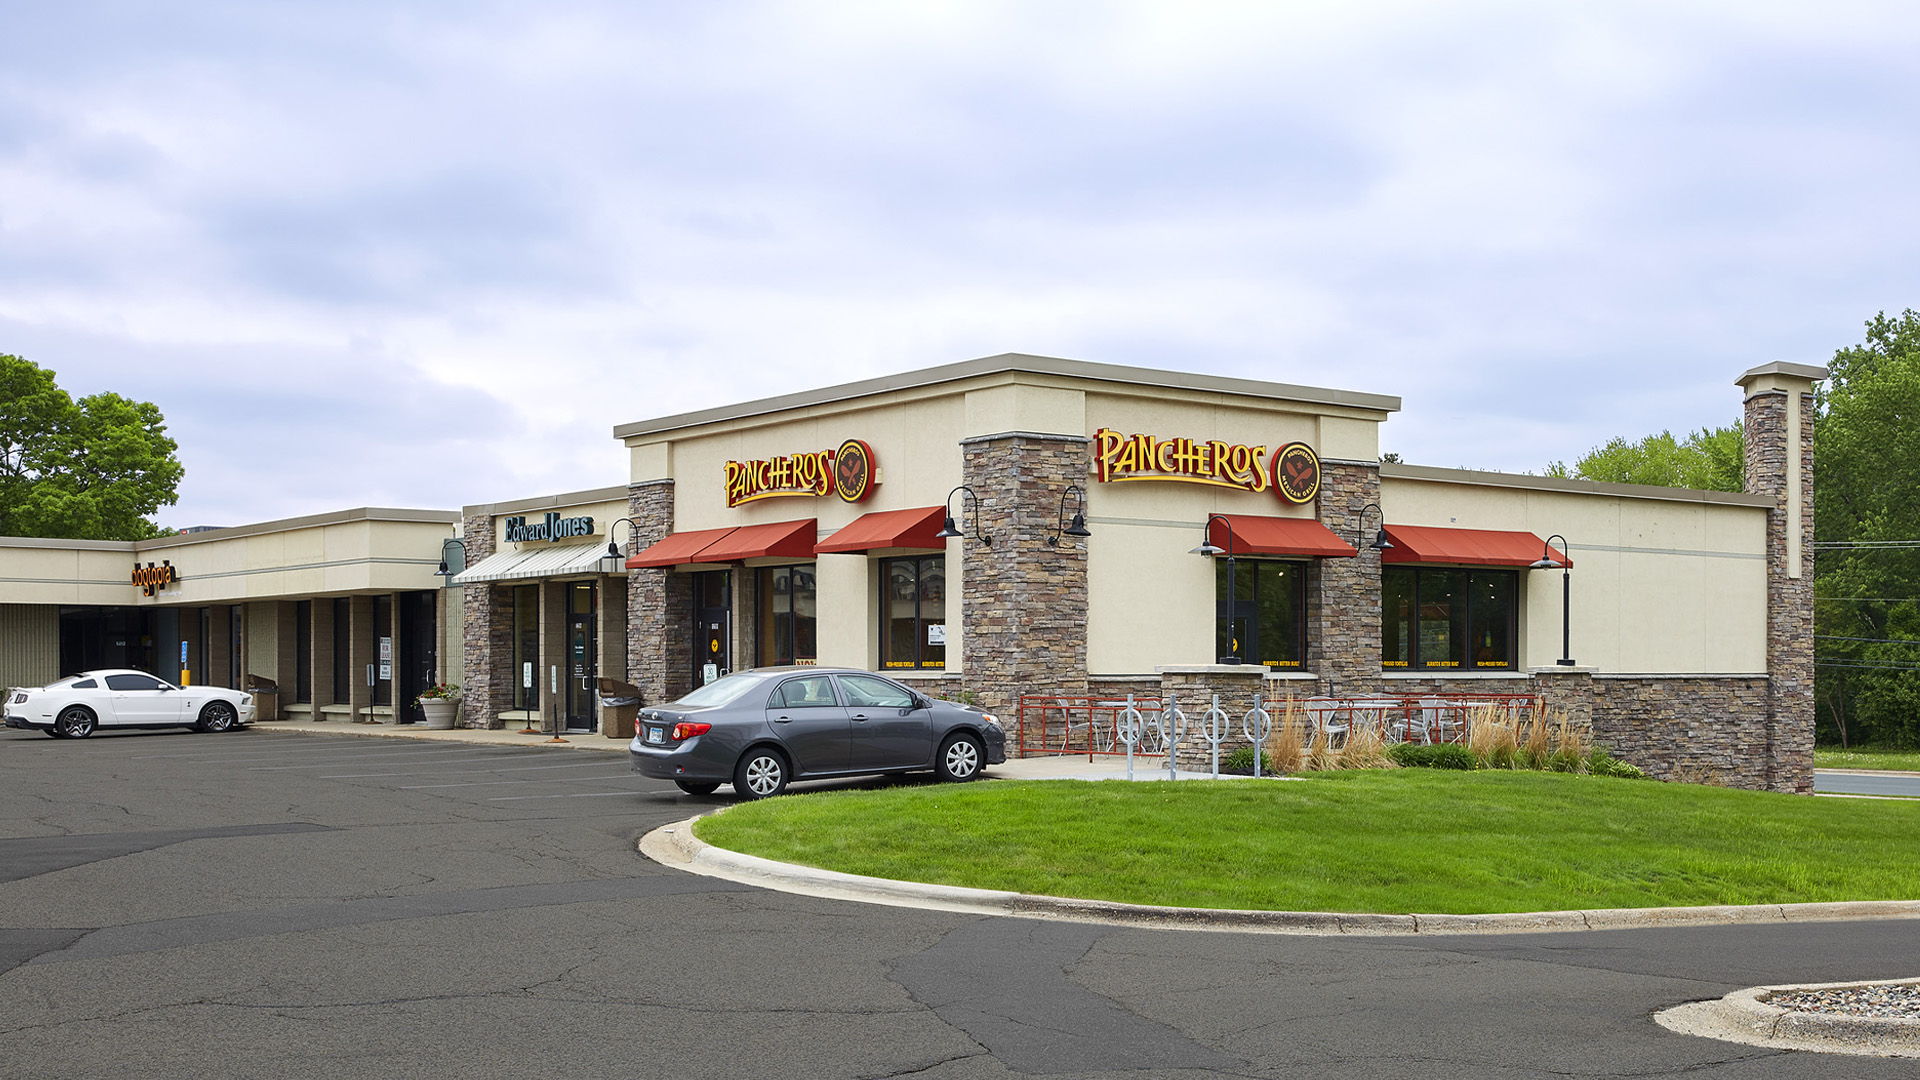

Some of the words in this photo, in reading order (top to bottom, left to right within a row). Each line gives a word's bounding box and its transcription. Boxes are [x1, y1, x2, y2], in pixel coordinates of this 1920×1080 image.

[840, 447, 860, 462] PANCHEROS
[1094, 428, 1267, 493] PANCHEROS
[1287, 449, 1314, 465] PANCHEROS
[724, 449, 835, 508] PANCHEROS
[839, 480, 856, 496] MEXICAN
[856, 473, 865, 491] GRILL
[1281, 475, 1302, 497] MEXICAN
[1302, 482, 1315, 497] GRILL
[504, 512, 548, 542] Edward
[548, 512, 595, 543] Jones
[131, 560, 177, 597] dogtopia
[707, 667, 714, 675] 30
